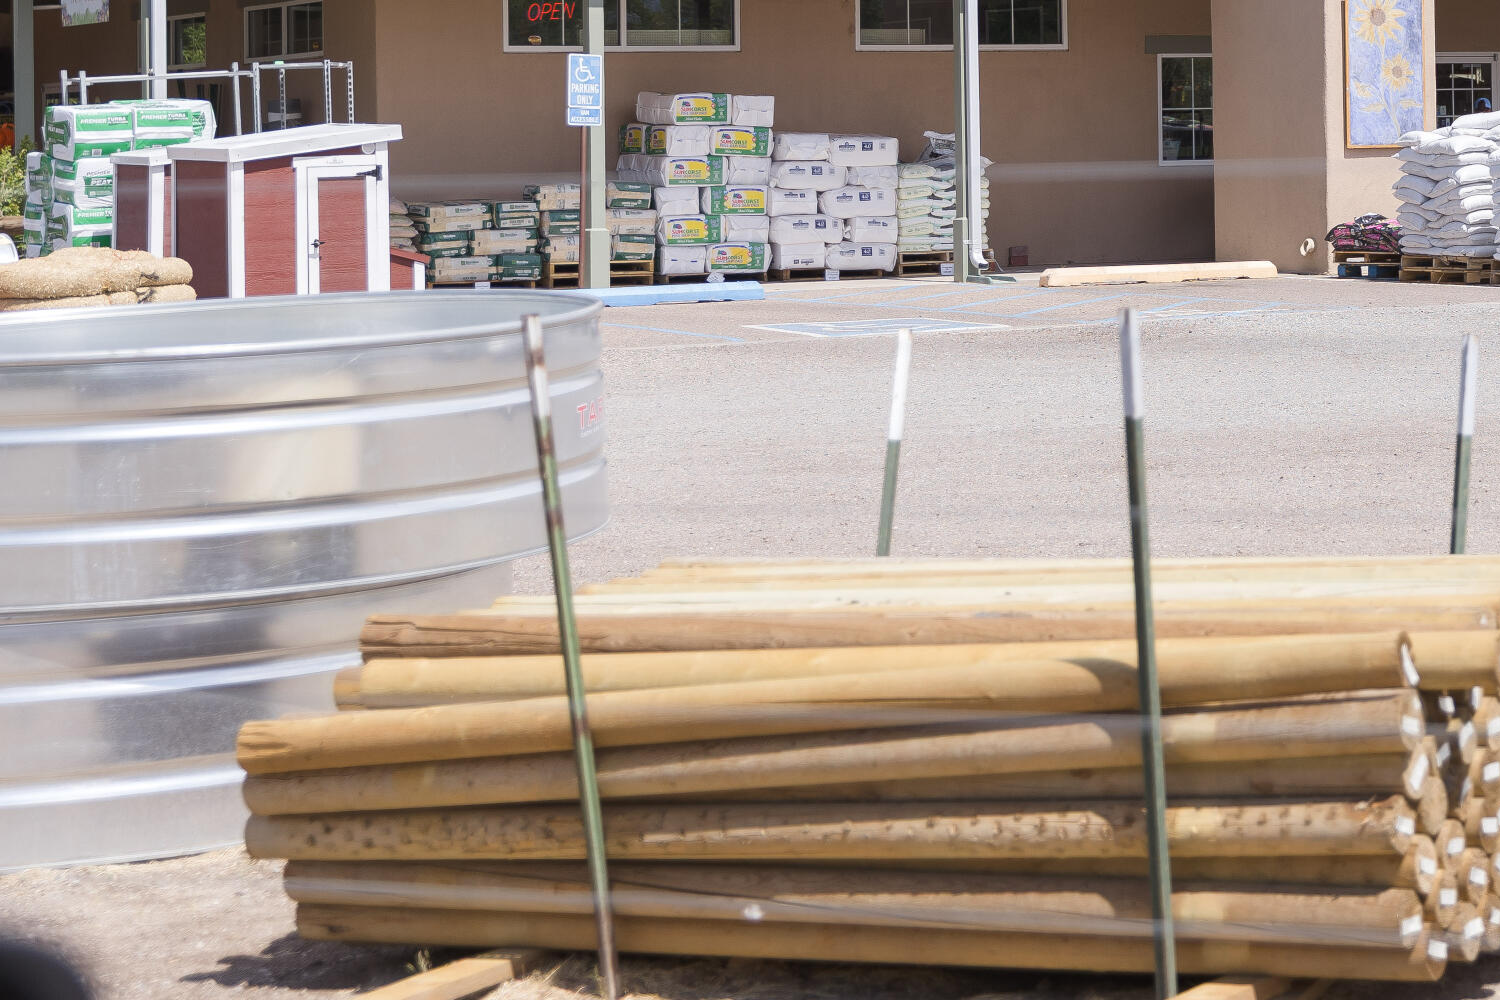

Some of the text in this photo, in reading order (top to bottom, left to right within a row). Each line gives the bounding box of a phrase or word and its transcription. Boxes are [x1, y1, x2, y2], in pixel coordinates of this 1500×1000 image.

[527, 1, 576, 22] OPEN
[571, 83, 600, 94] PARKING
[576, 94, 594, 105] ONLY
